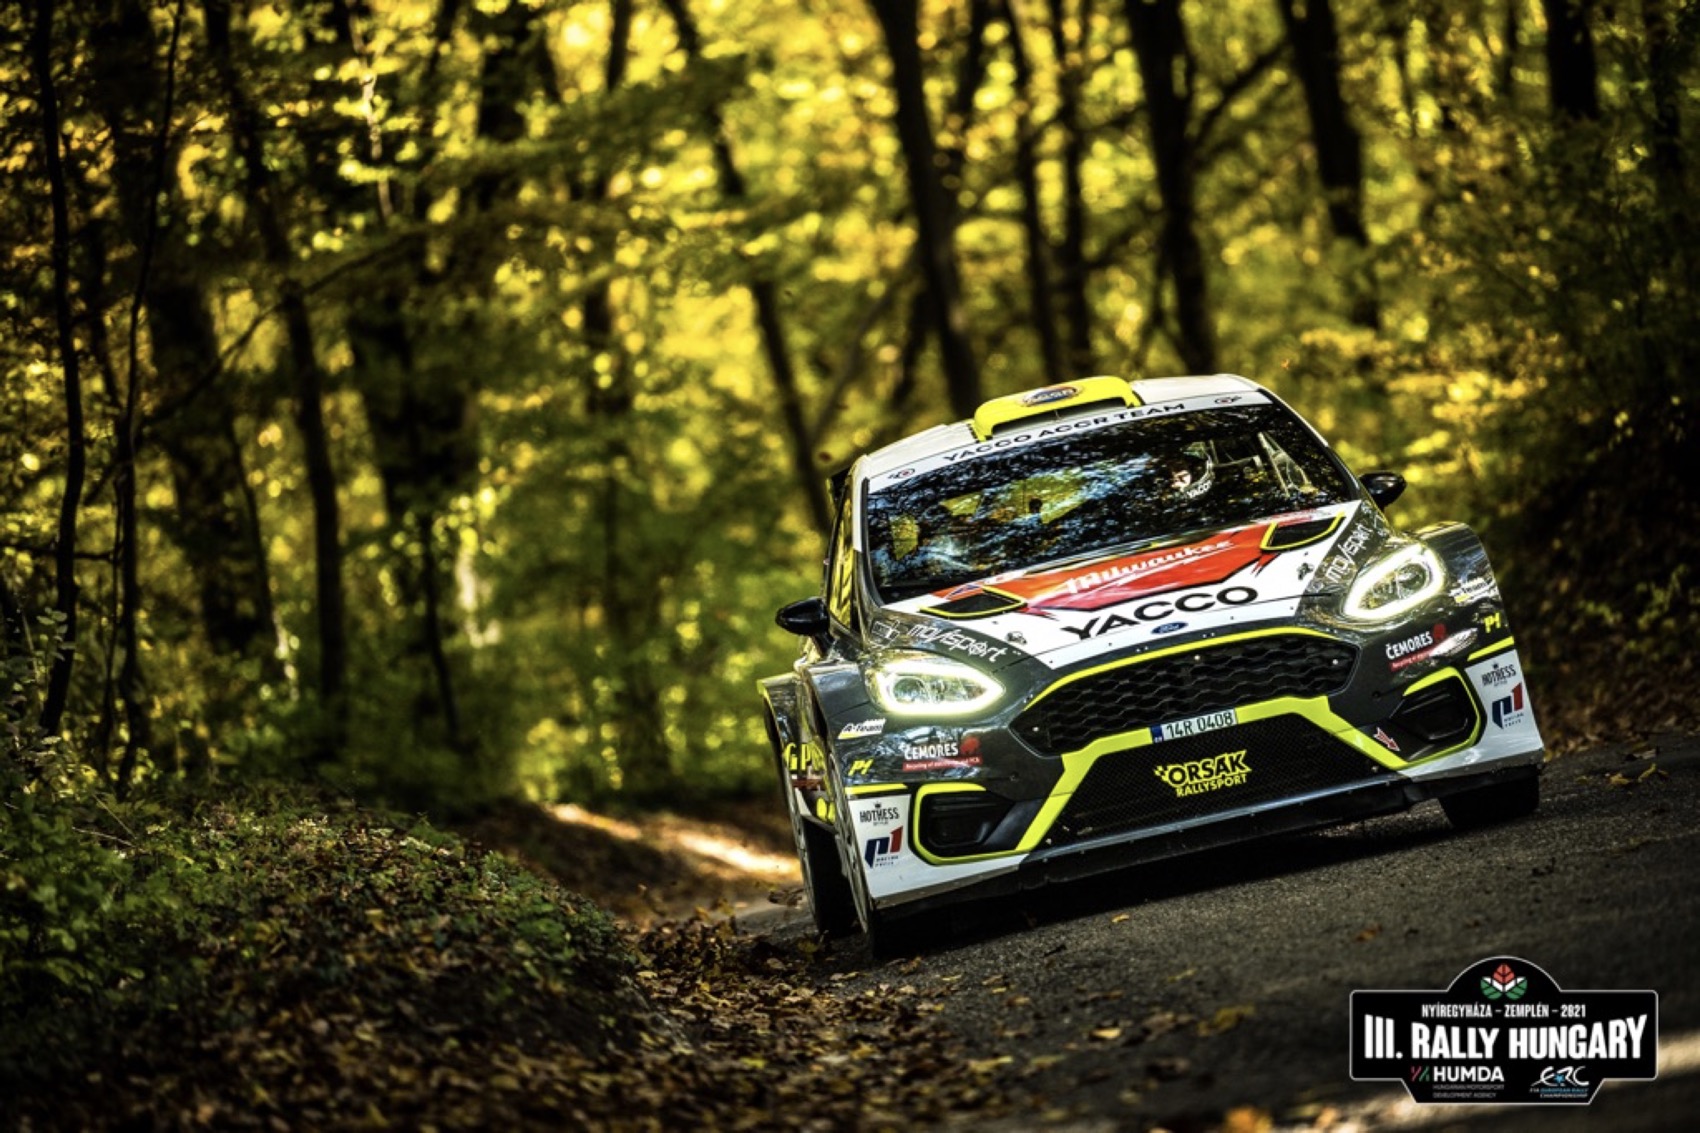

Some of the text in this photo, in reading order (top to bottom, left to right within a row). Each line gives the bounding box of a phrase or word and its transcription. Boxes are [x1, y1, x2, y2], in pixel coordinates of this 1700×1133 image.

[943, 434, 1032, 461] YACCO
[1114, 403, 1185, 420] TEAM
[1064, 540, 1235, 593] Milwaukee
[1060, 586, 1258, 640] YACCO
[1385, 631, 1434, 660] ČEMORES
[1197, 712, 1234, 731] 0408
[1176, 774, 1247, 797] RALLYSPORT
